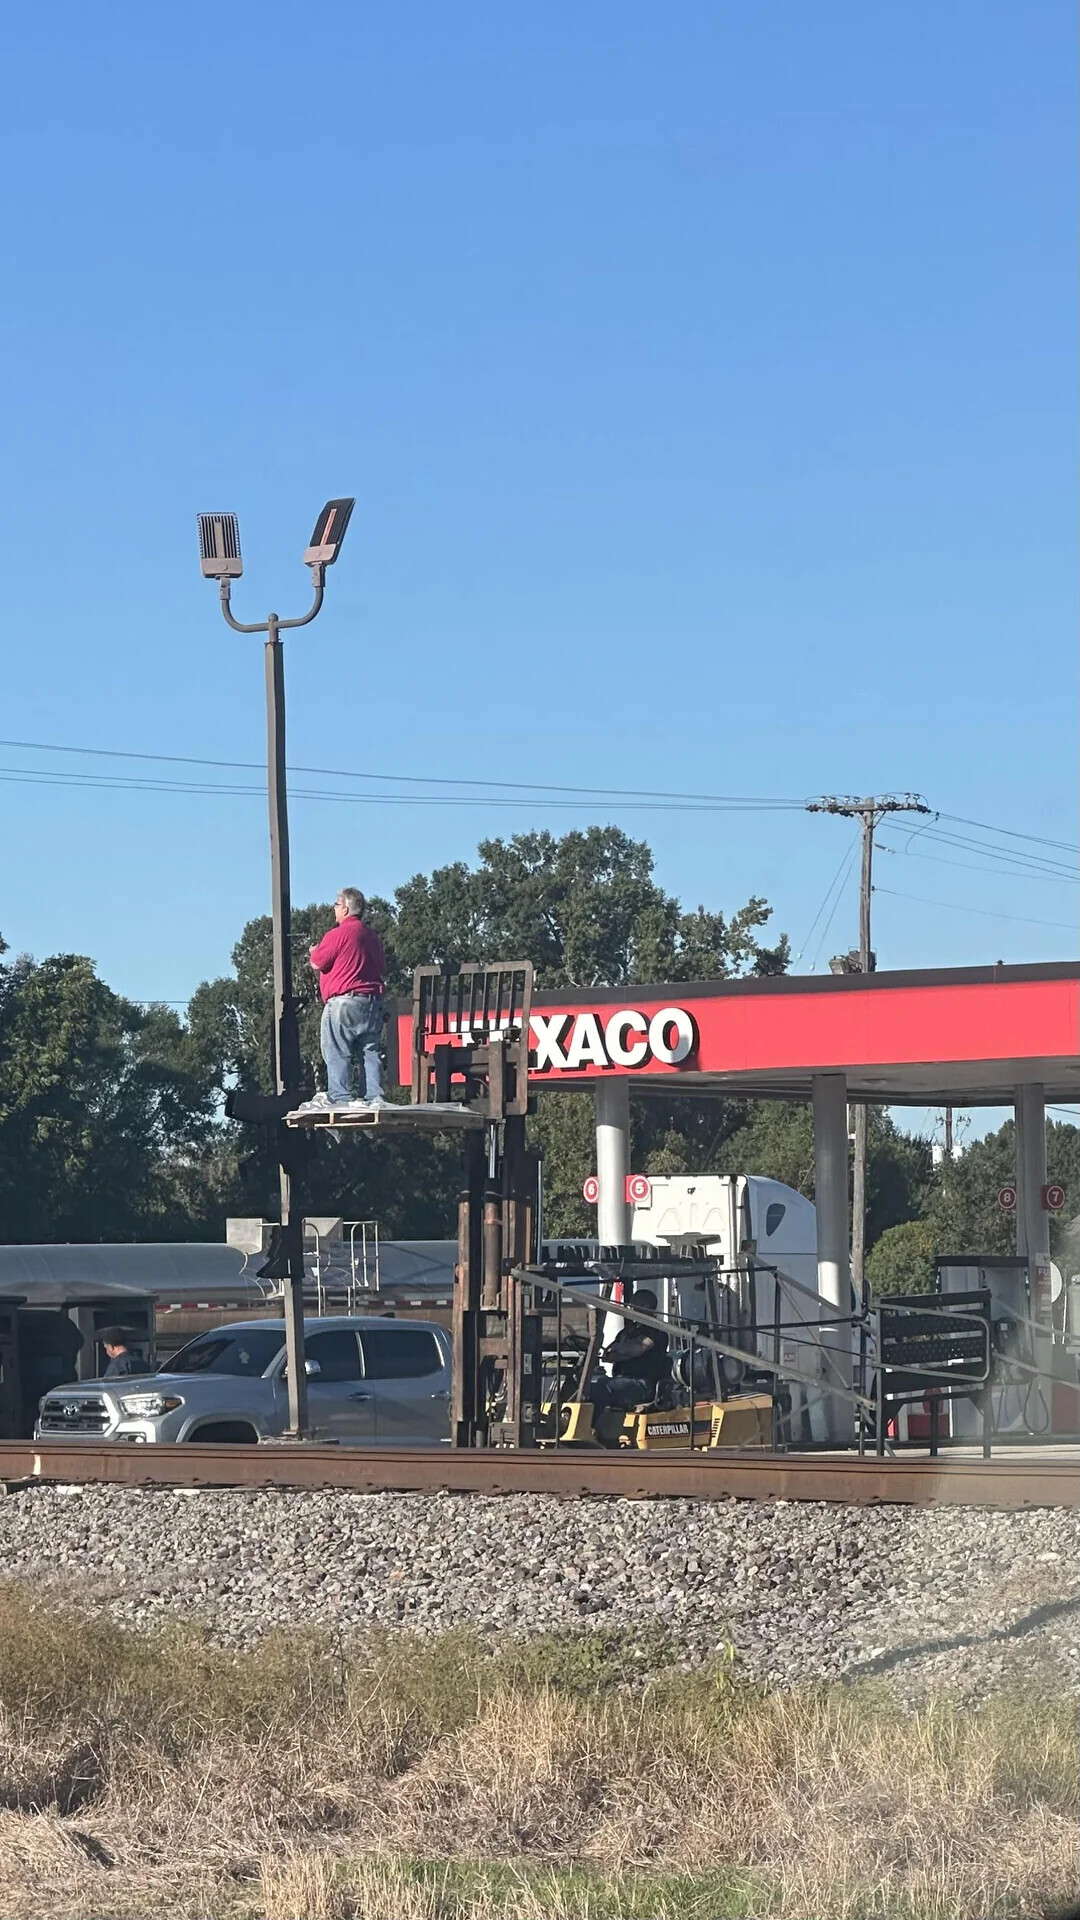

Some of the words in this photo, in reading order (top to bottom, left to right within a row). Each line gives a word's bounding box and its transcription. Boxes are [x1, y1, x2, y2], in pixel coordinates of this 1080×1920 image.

[449, 1007, 696, 1073] XACO
[588, 1183, 595, 1196] 6
[635, 1182, 645, 1195] 5
[1003, 1192, 1012, 1203] 8
[1052, 1191, 1060, 1202] 7
[647, 1424, 689, 1435] CATERPILLAR
